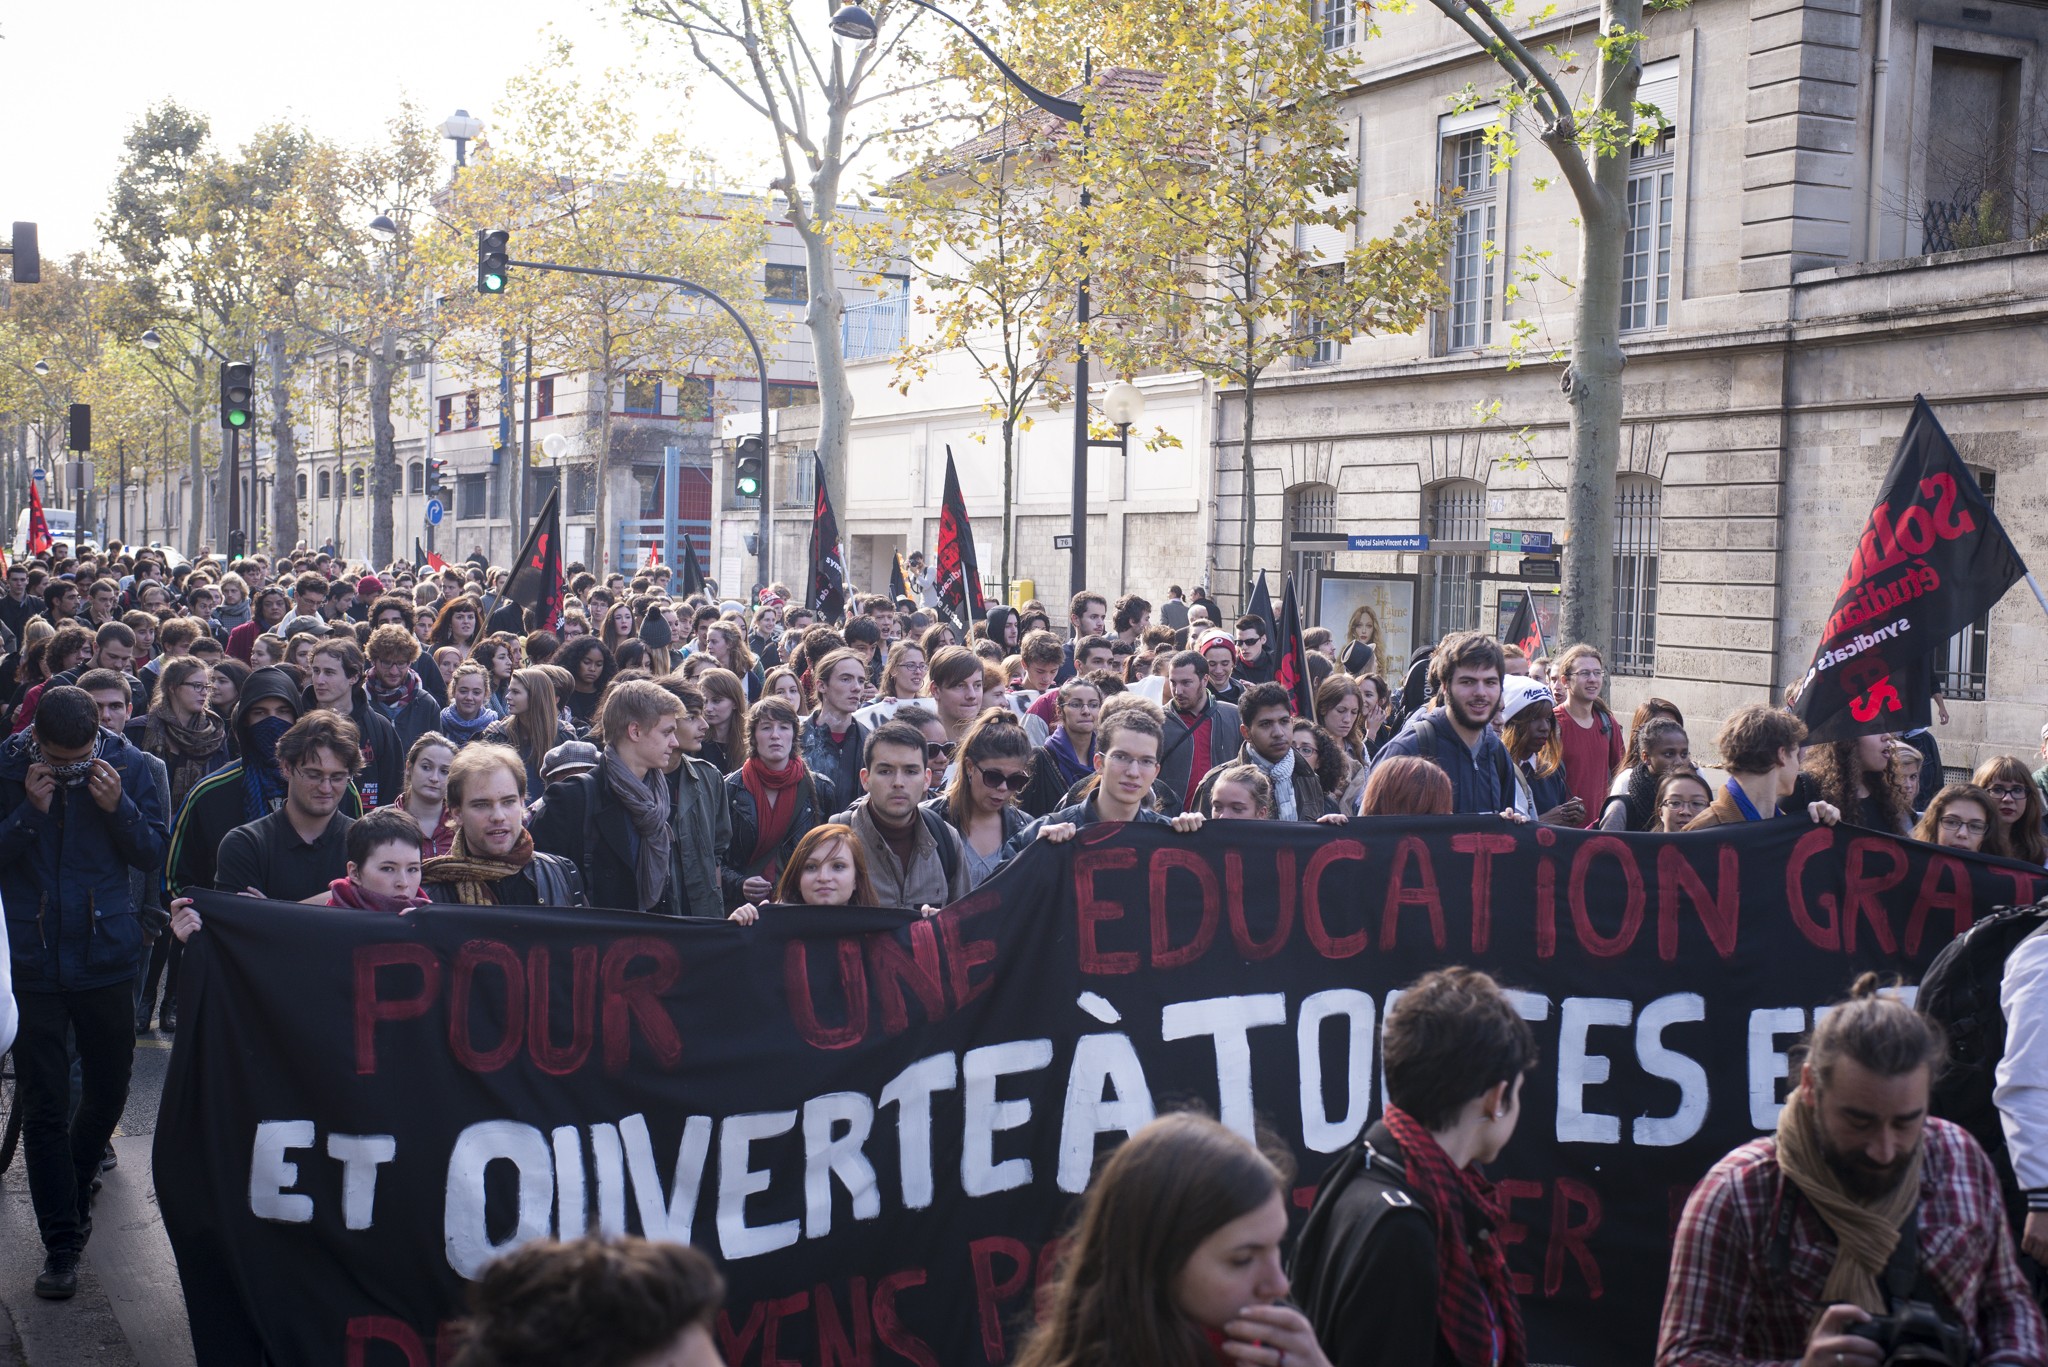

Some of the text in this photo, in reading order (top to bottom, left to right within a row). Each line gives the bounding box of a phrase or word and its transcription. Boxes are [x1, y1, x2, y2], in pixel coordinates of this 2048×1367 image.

[1492, 499, 1503, 511] 76
[1355, 538, 1371, 547] Hôpital
[1523, 689, 1542, 699] New
[352, 937, 683, 1076] POUR
[786, 893, 998, 1049] UNE
[247, 1119, 396, 1231] ET
[1058, 991, 1156, 1194] À
[1162, 987, 1711, 1153] TOES
